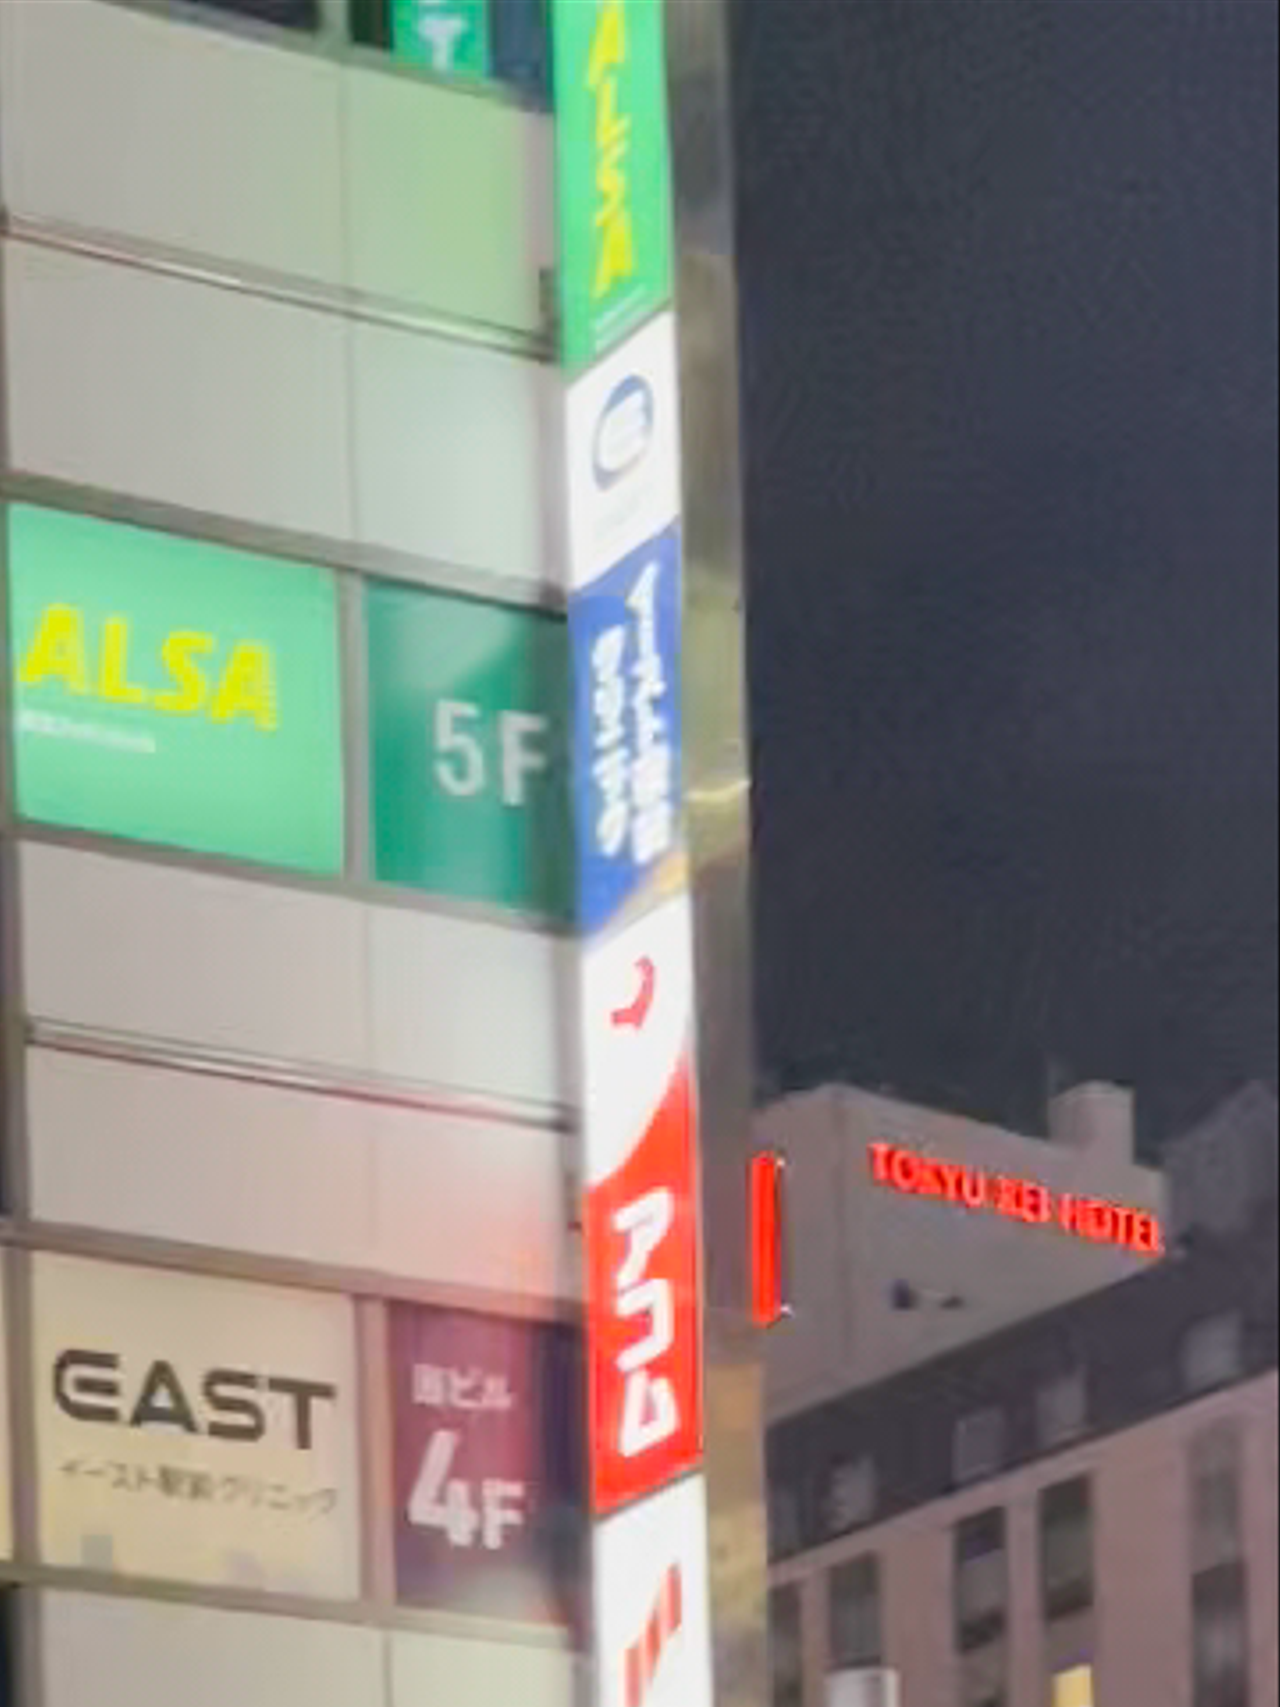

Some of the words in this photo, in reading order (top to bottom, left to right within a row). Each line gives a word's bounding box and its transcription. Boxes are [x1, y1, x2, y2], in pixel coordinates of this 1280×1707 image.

[19, 602, 277, 734] ALSA
[433, 700, 549, 808] 5F
[864, 1142, 987, 1208] TOKYU
[1059, 1194, 1165, 1257] HOTEL
[613, 1188, 680, 1457] アコム
[53, 1348, 337, 1450] EAST
[407, 1429, 525, 1550] 4F
